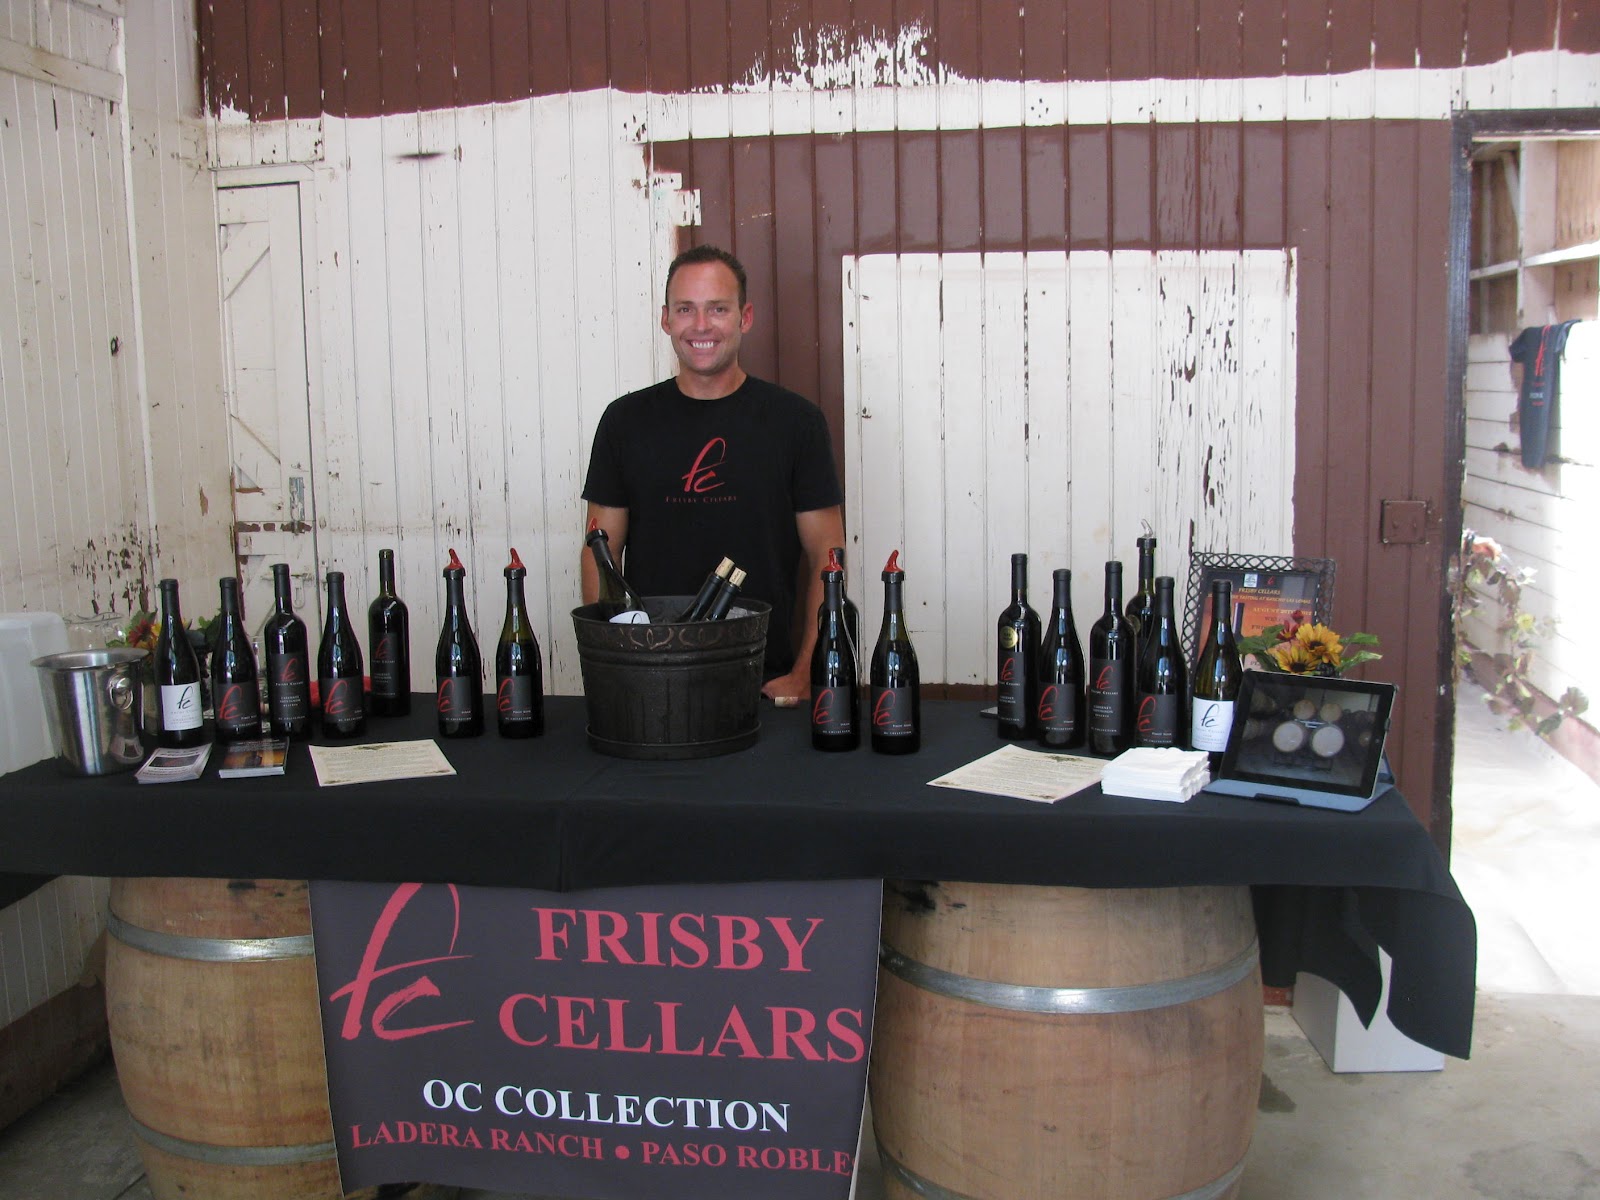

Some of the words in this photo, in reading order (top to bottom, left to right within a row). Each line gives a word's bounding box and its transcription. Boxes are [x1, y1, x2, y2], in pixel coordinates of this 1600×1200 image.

[532, 907, 824, 973] FRISBY
[498, 993, 865, 1064] CELLARS
[423, 1079, 482, 1113] OC
[495, 1085, 790, 1133] COLLECTION
[350, 1121, 483, 1150] LADERA
[490, 1128, 604, 1160] RANCH
[641, 1141, 728, 1167] PASO
[737, 1145, 856, 1177] ROBLE
